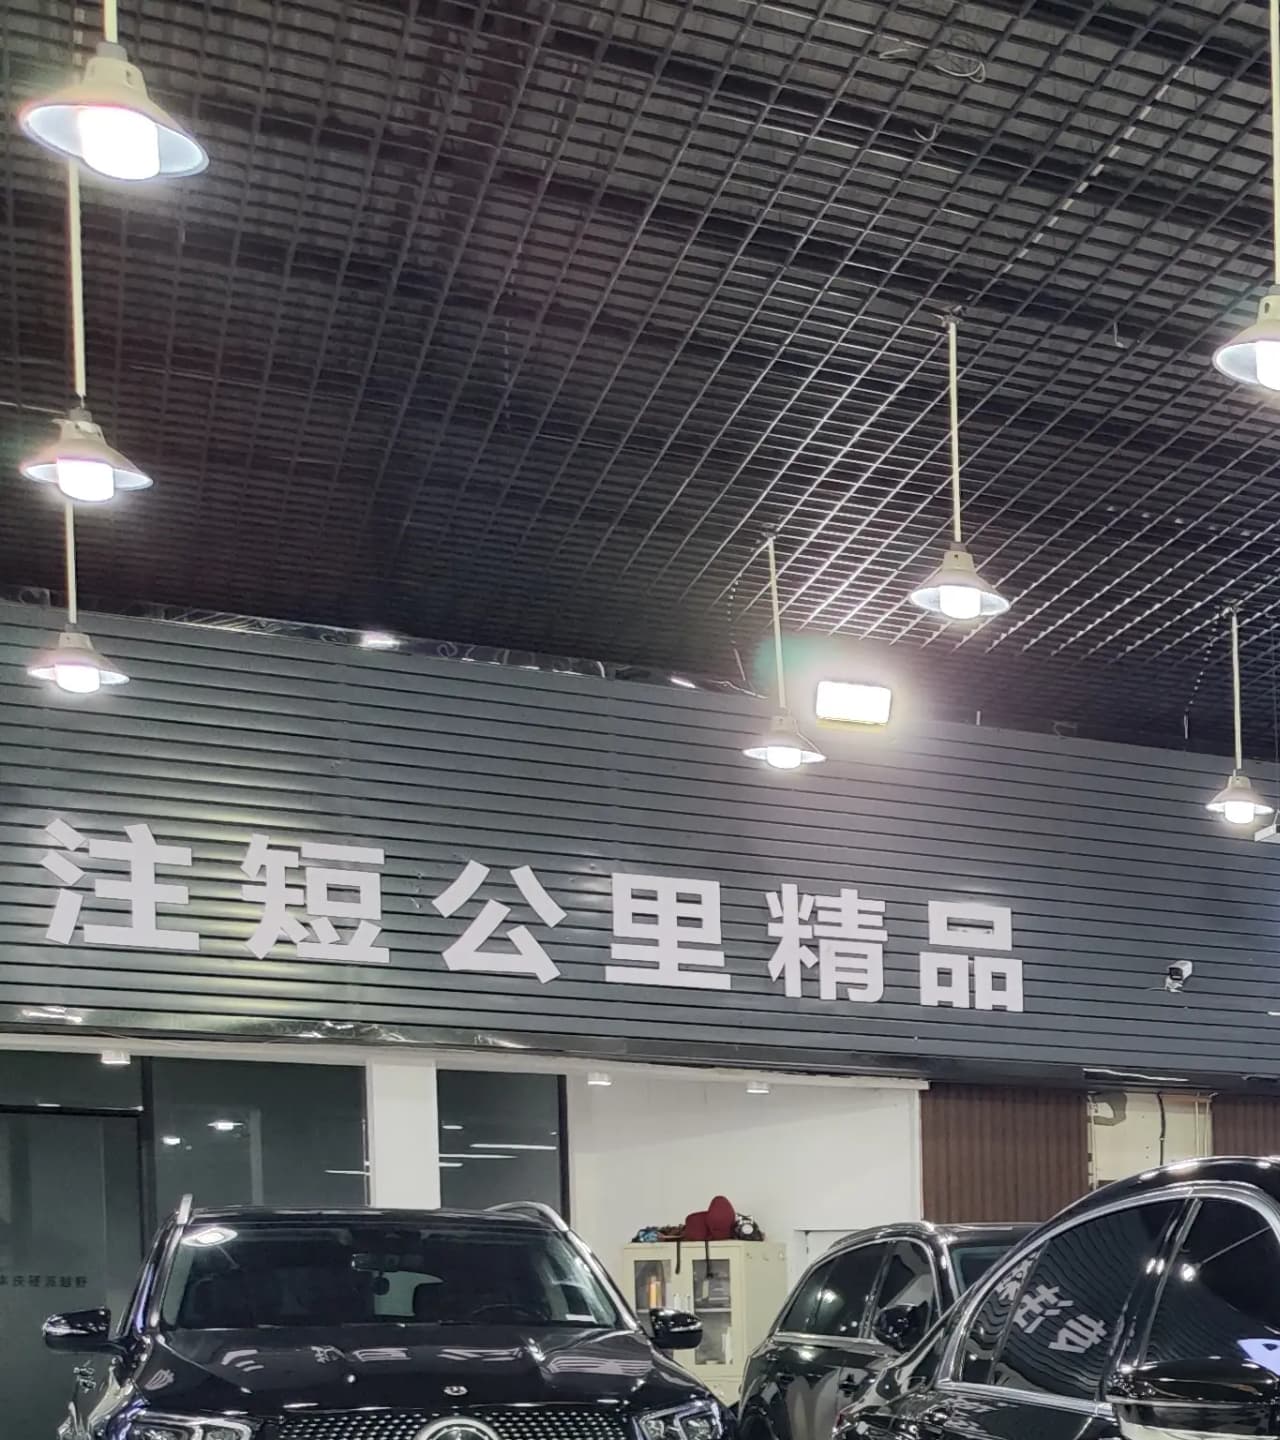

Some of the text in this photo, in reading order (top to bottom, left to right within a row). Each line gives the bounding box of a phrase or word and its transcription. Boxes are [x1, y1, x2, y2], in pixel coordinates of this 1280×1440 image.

[41, 816, 1025, 1013] 注短公里精品
